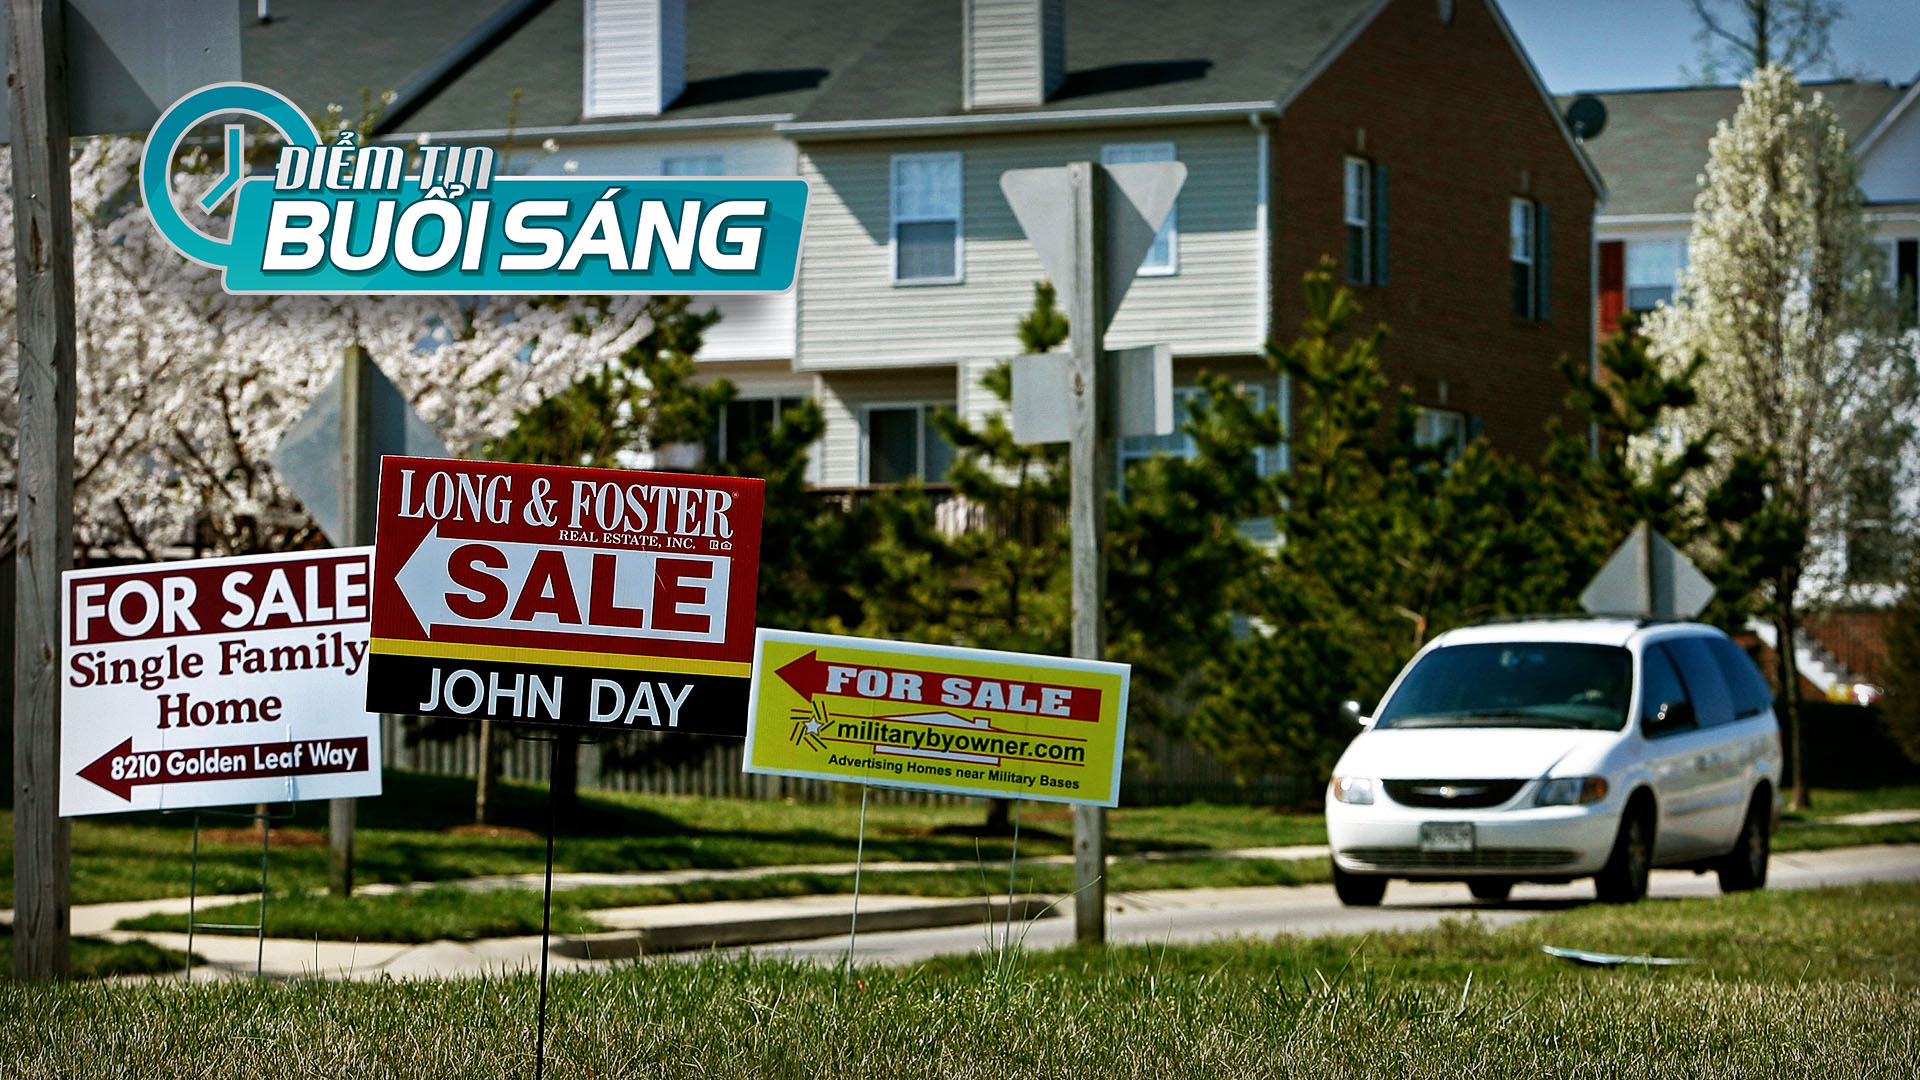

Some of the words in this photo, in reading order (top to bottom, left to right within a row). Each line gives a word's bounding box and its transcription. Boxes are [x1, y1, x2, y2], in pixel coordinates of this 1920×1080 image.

[398, 469, 513, 524] LONG
[523, 477, 558, 527] &
[558, 530, 599, 543] REAL
[602, 532, 662, 548] ESTATE,
[666, 538, 697, 550] INC.
[76, 576, 201, 641] FOR
[220, 562, 367, 628] SALE
[444, 543, 714, 634] SALE
[69, 644, 203, 690] Single
[219, 632, 369, 676] Family
[157, 692, 282, 729] Home
[420, 668, 563, 720] JOHN
[589, 679, 694, 727] DAY
[826, 665, 923, 701] FOR
[941, 677, 1073, 716] SALE
[111, 753, 161, 780] 8210
[166, 748, 246, 774] Golden
[254, 743, 303, 771] Leaf
[308, 741, 358, 769] Way
[837, 720, 1085, 762] militarybyowner.com
[828, 753, 903, 775] Advertising
[907, 761, 952, 777] Homes
[956, 767, 985, 780] near
[988, 769, 1036, 787] Military
[1040, 775, 1080, 790] Bases
